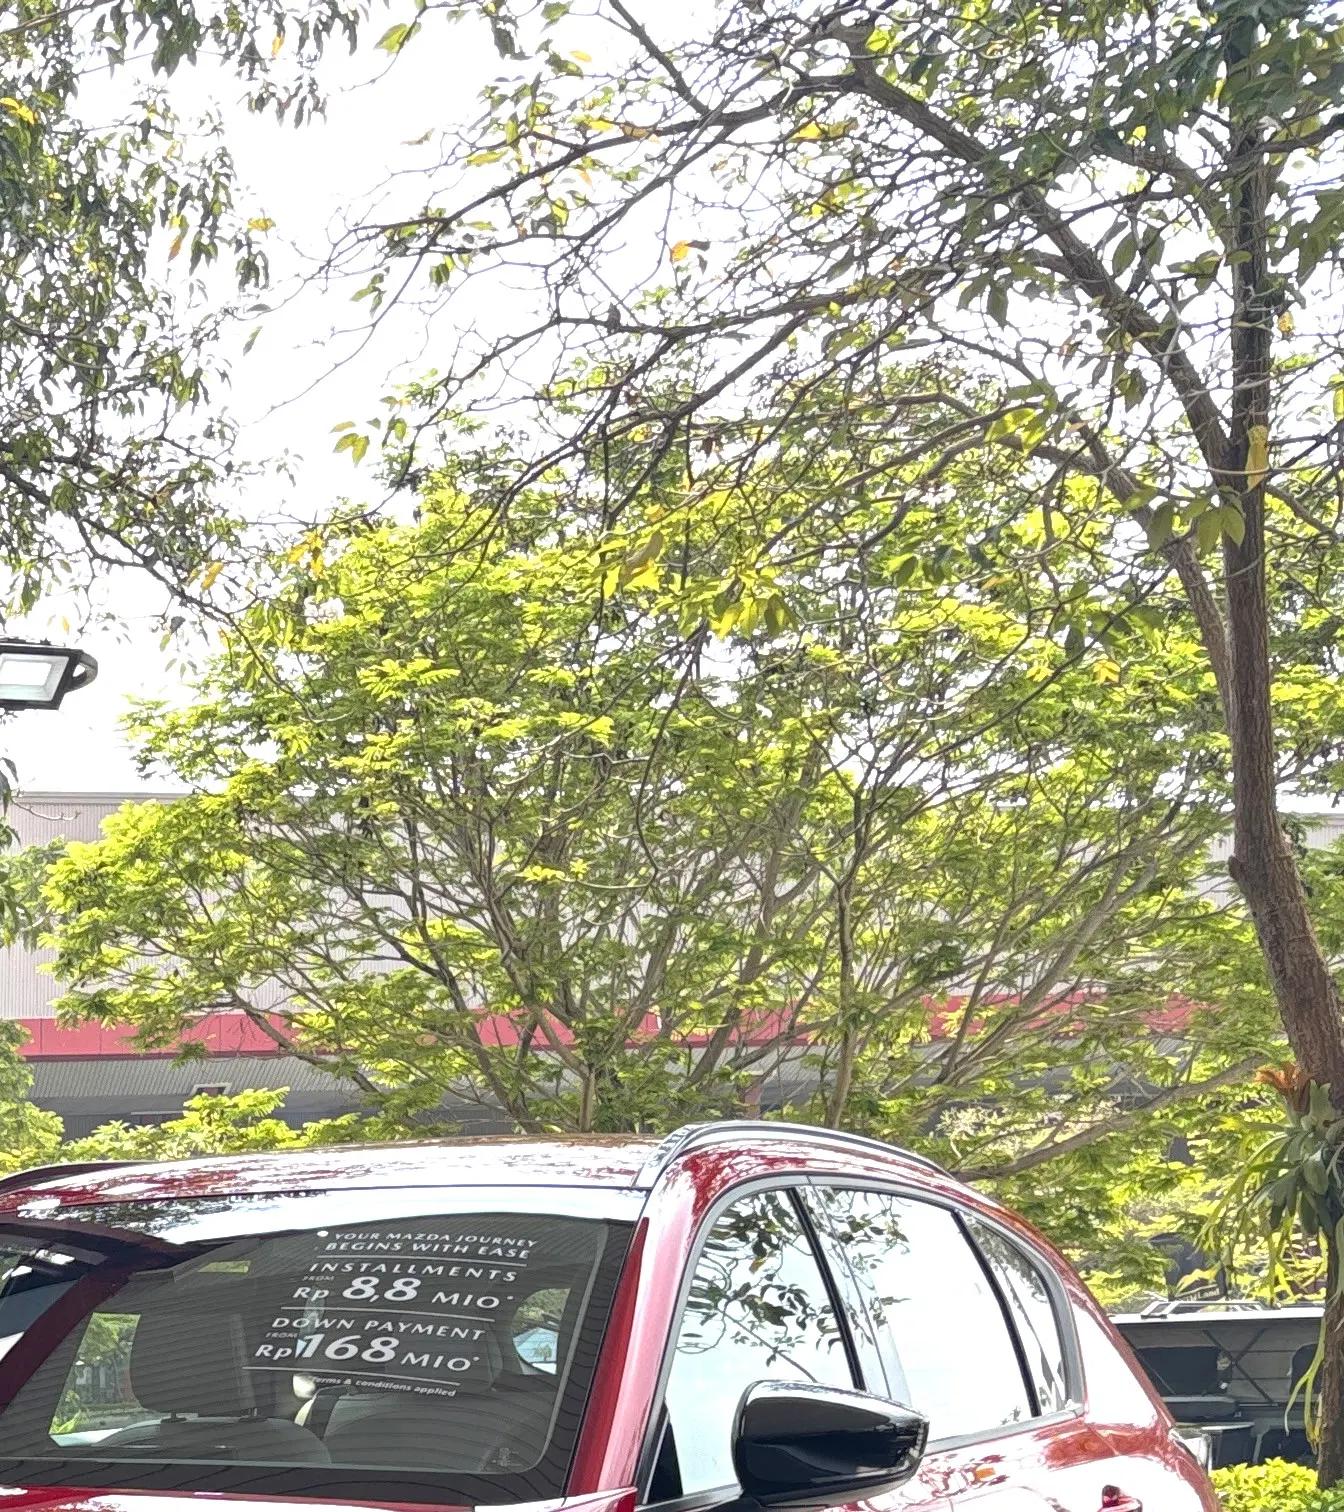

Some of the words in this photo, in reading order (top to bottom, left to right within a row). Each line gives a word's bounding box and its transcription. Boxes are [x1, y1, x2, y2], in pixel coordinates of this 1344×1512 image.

[334, 1232, 379, 1240] YOUR
[386, 1232, 450, 1242] MAZDA
[455, 1235, 538, 1248] JOURNEY
[325, 1241, 402, 1251] BEGINS
[412, 1242, 470, 1254] WITH
[478, 1246, 531, 1260] EASE
[309, 1262, 518, 1282] INSTALLMENTS
[292, 1286, 330, 1300] Rp
[342, 1276, 422, 1303] 8,8
[271, 1317, 355, 1329] DOWN
[364, 1319, 485, 1341] PAYMENT
[254, 1344, 293, 1361] Rp
[301, 1333, 400, 1363] 168
[414, 1386, 458, 1398] applied
